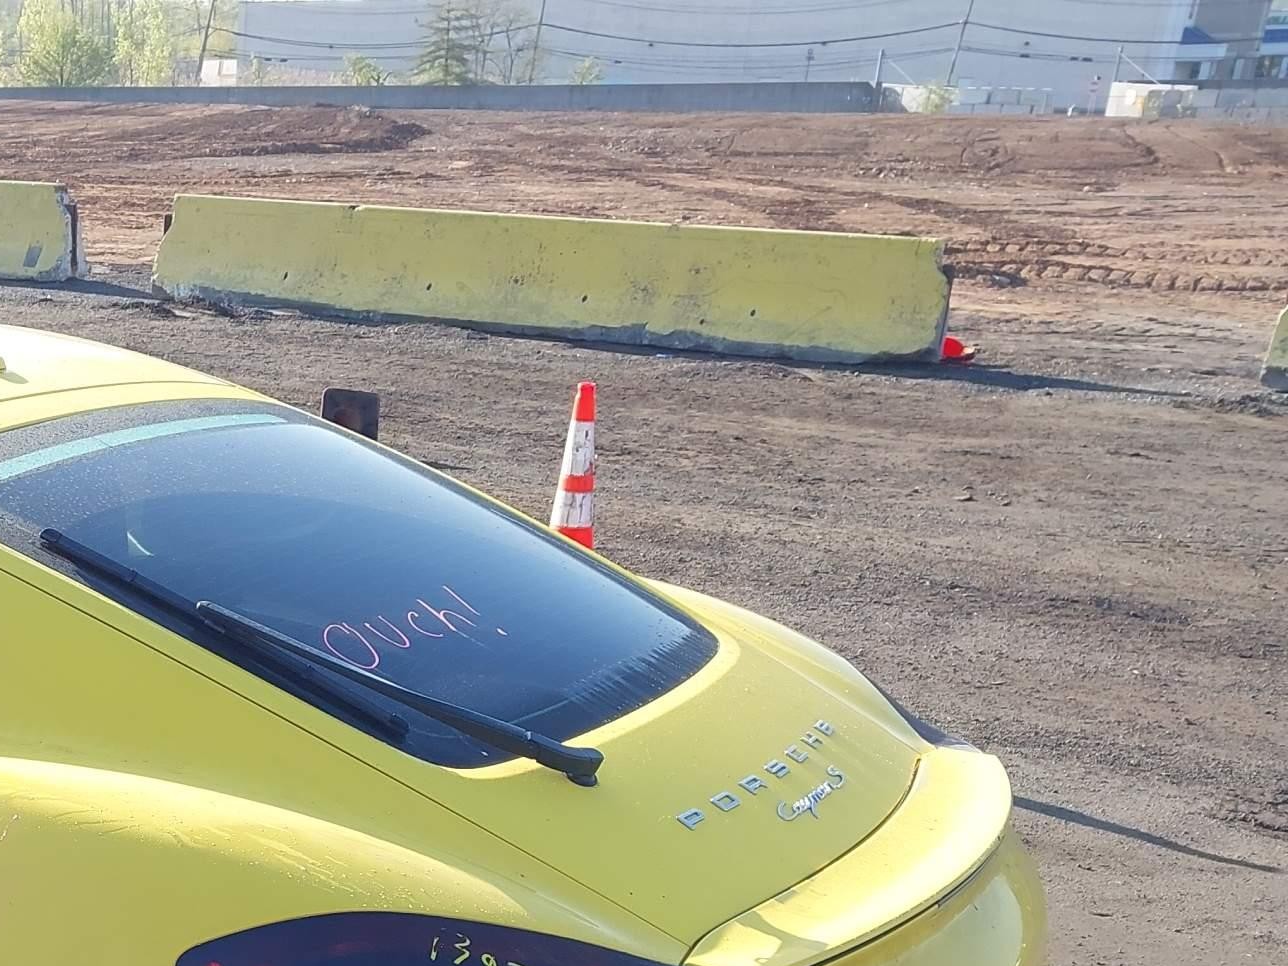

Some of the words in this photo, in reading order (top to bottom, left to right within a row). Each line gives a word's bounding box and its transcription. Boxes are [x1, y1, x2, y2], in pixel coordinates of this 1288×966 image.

[675, 719, 835, 831] PORSCHE
[777, 780, 835, 822] Cayman
[827, 764, 846, 789] S
